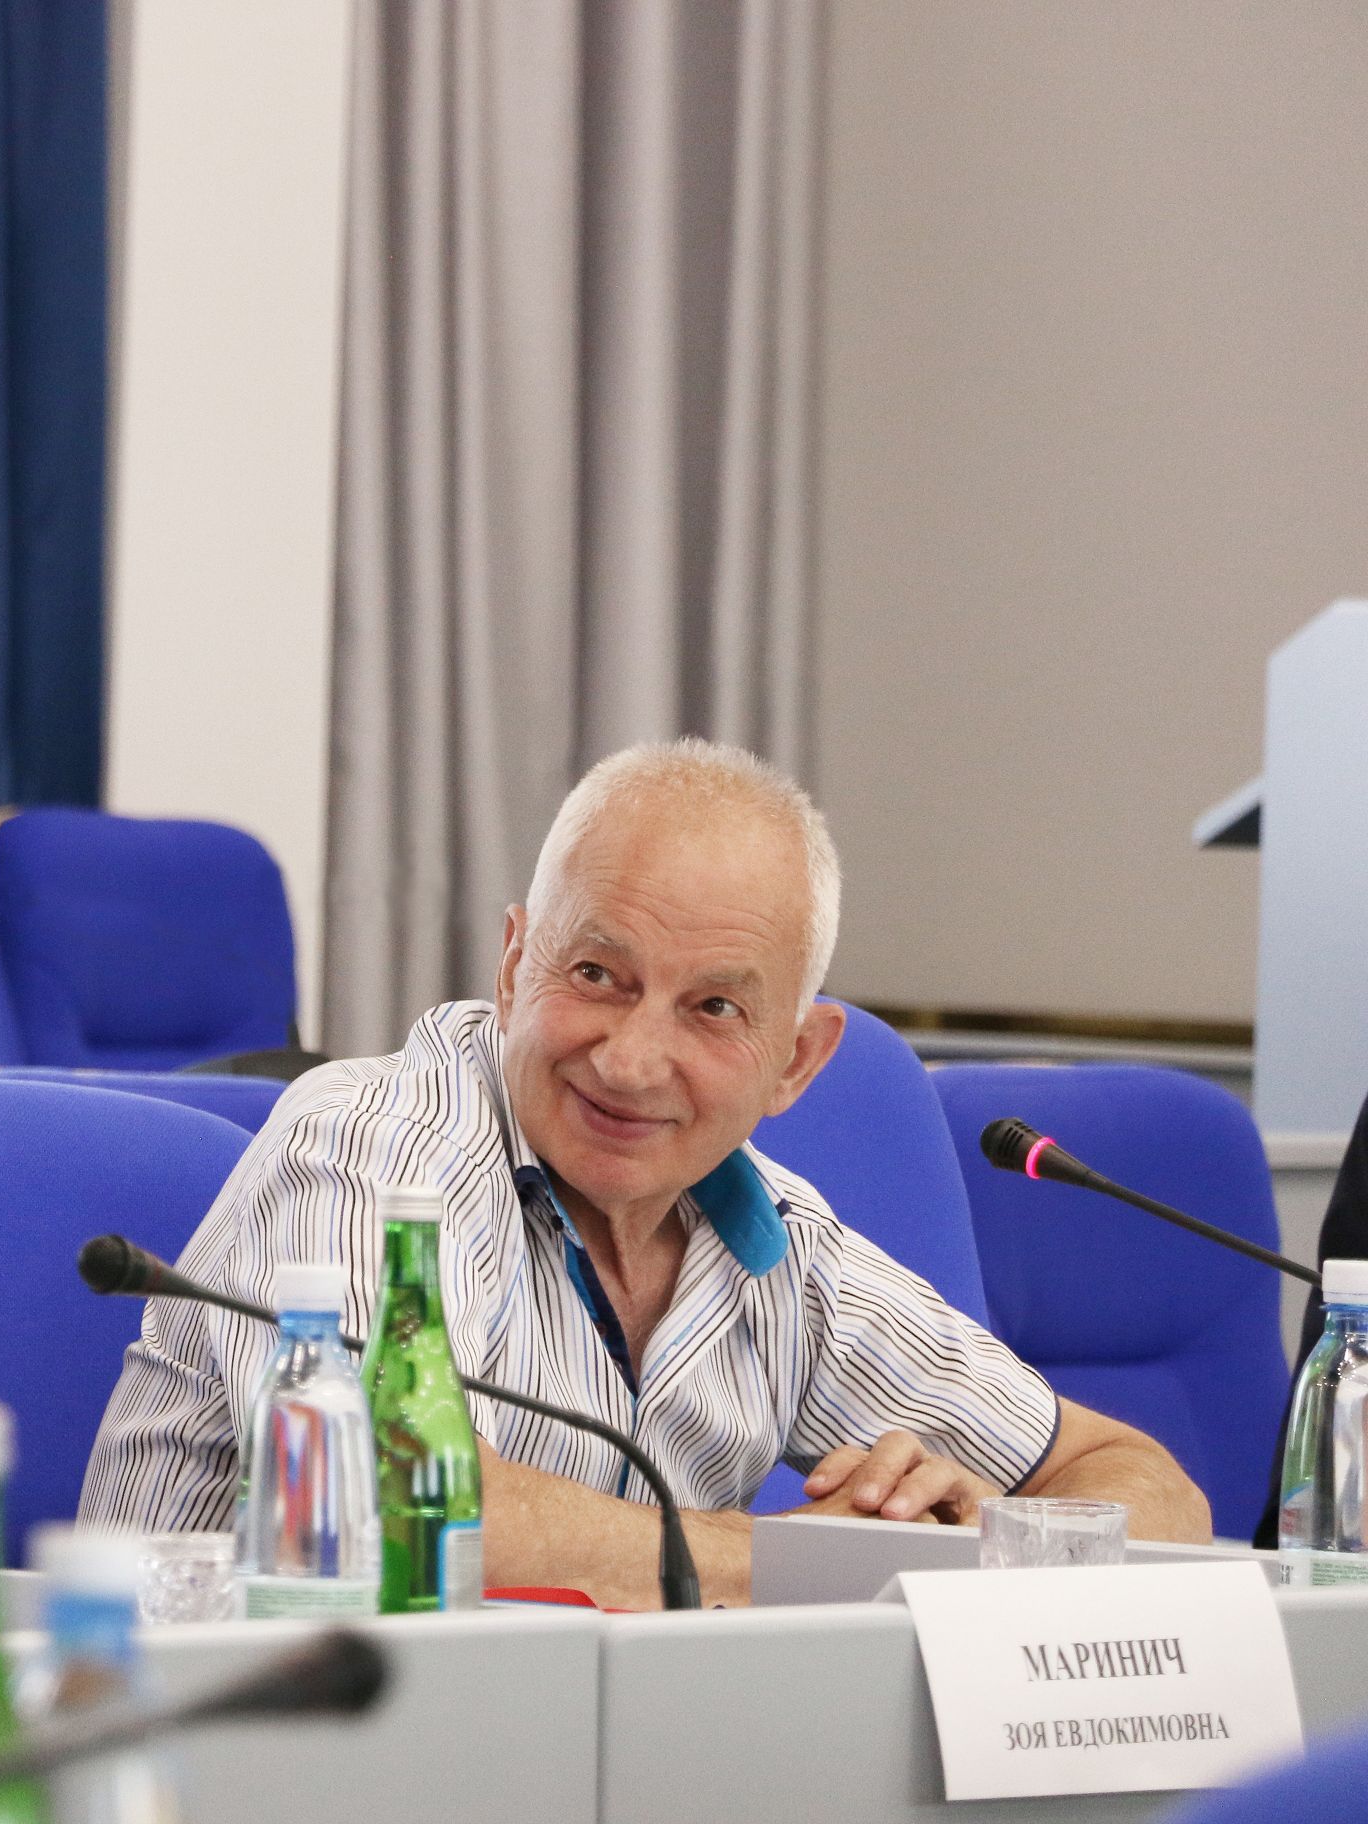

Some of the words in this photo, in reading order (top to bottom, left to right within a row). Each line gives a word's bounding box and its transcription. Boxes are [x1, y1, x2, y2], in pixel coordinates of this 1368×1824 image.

[1020, 1638, 1187, 1681] МАРИНИЧ
[1003, 1720, 1049, 1751] ЗОЯ
[1052, 1713, 1230, 1749] ЕВДОКИМОВНА
